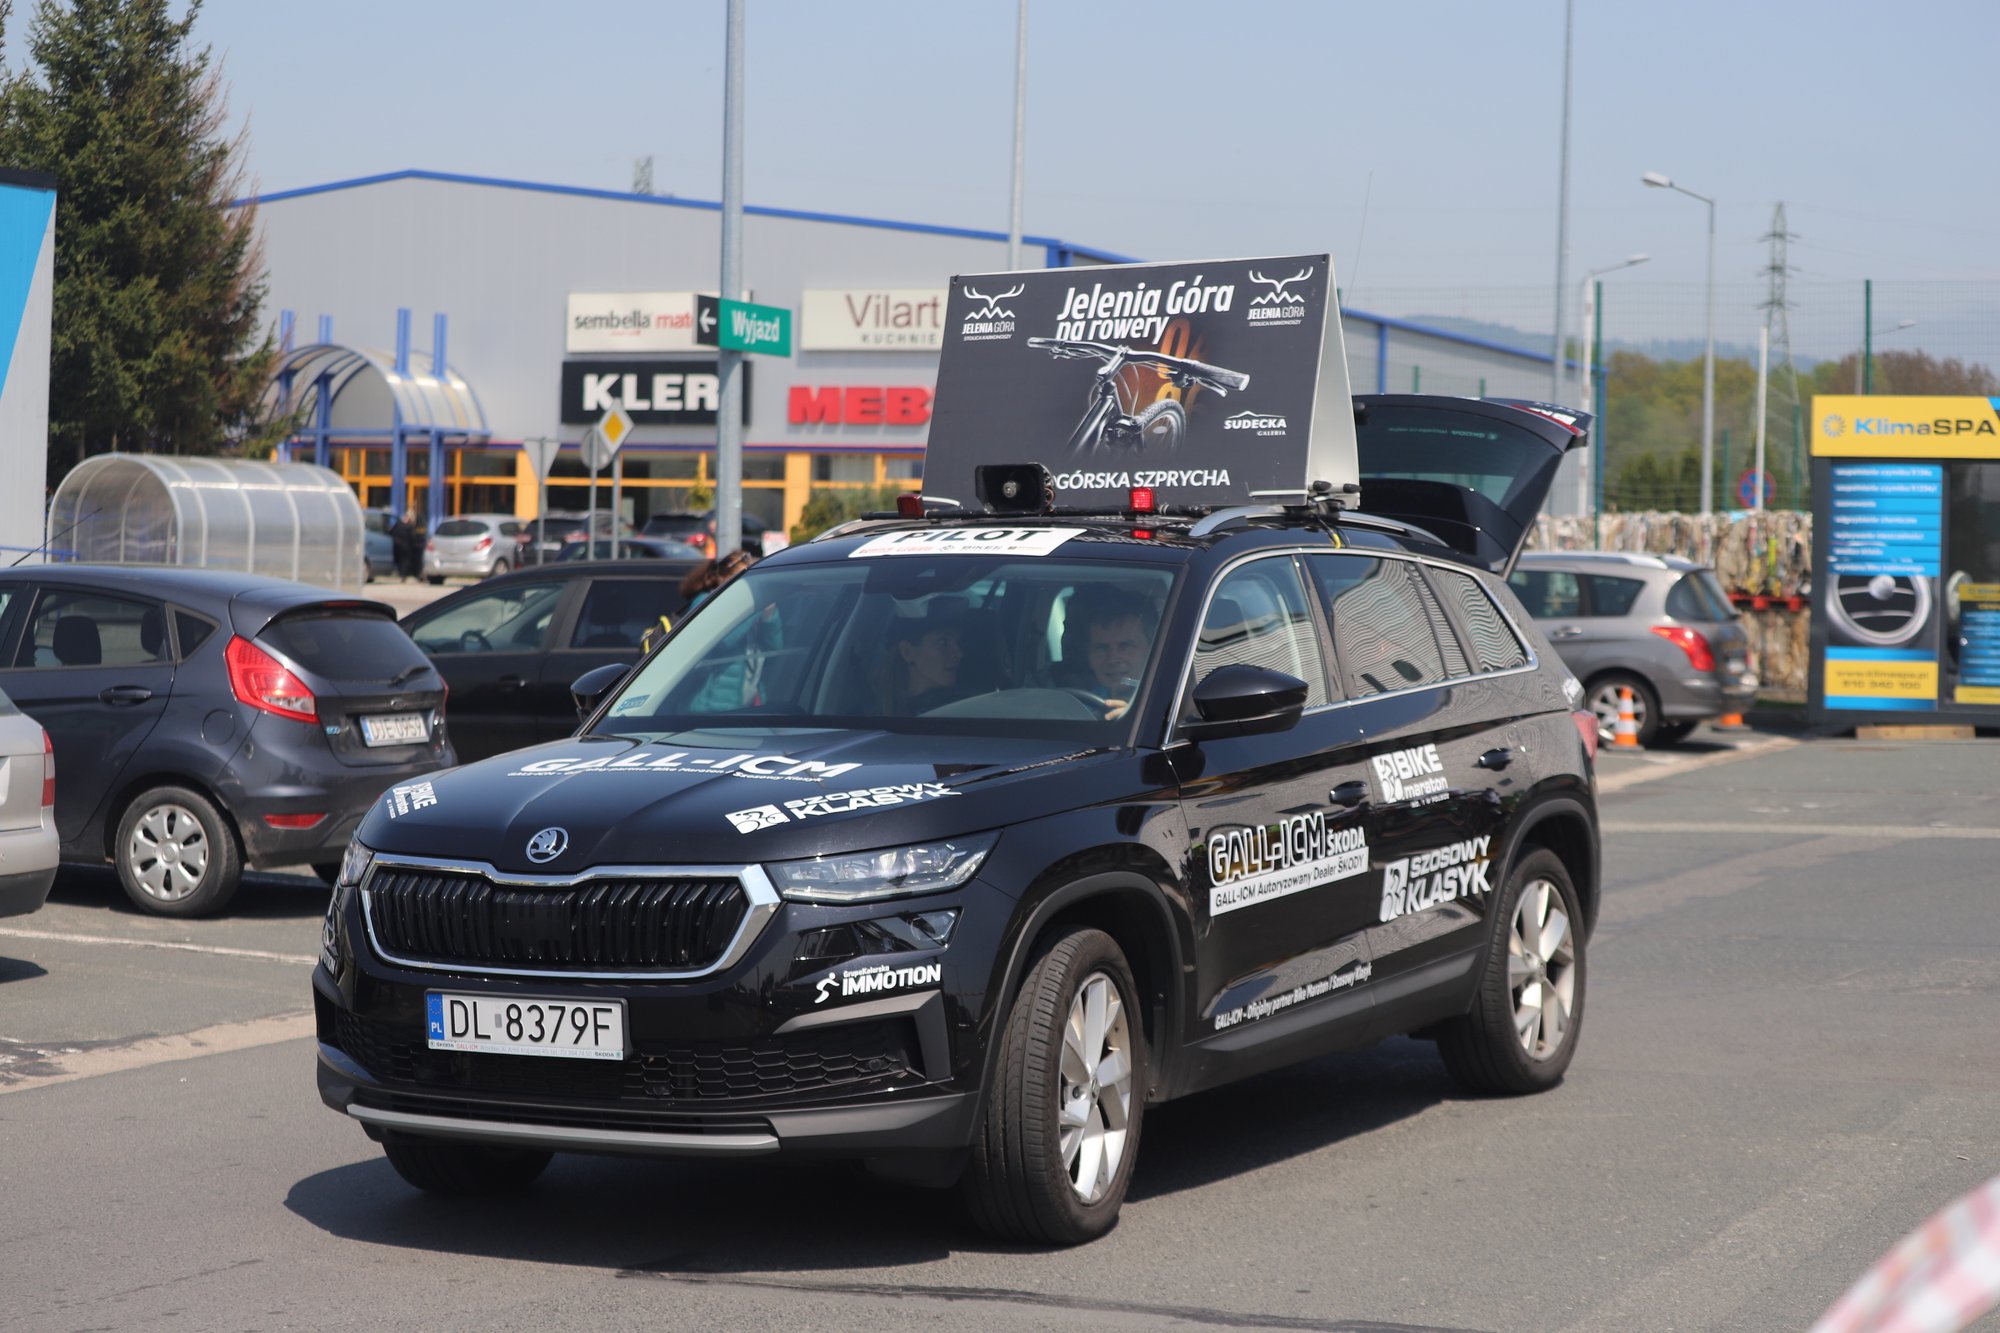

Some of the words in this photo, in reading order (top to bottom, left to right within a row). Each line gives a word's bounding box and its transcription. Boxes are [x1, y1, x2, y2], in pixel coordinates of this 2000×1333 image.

[845, 293, 941, 330] Vilart
[1056, 282, 1162, 321] Jelenia
[1166, 275, 1235, 315] Góra
[1247, 307, 1281, 320] JELENIA
[1281, 305, 1305, 318] GÓRA
[574, 310, 650, 330] sembella
[731, 308, 780, 343] Wyjazd
[962, 322, 993, 334] JELENIA
[993, 320, 1015, 333] GÓRA
[1055, 319, 1087, 341] na
[1087, 316, 1170, 345] rowery
[861, 333, 938, 345] KUCHNIE
[583, 374, 719, 411] KLER
[1224, 418, 1287, 430] SUDECKA
[1854, 418, 1997, 436] KlimaSPA
[1133, 468, 1231, 488] SZPRYCHA
[893, 530, 1051, 544] PILOT
[520, 753, 863, 778] GALL-ICM
[1392, 743, 1443, 779] BIKE
[783, 782, 945, 808] SZOSOWY
[789, 787, 962, 820] KLASYK
[1404, 776, 1449, 800] maraton
[1209, 811, 1326, 887] GALL-ICM
[1327, 826, 1366, 857] ŠKODA
[1410, 835, 1491, 879] SZOSOWY
[1215, 885, 1256, 907] GALL-ICM
[1257, 871, 1313, 896] Autoryzowany
[1313, 864, 1337, 880] Dealer
[1337, 854, 1365, 874] ŠKODY
[1406, 859, 1492, 915] KLASYK
[842, 963, 941, 996] IMMOTION
[450, 999, 492, 1040] DL
[506, 1003, 613, 1046] 8379F
[1214, 1008, 1243, 1031] GALL-ICM
[1271, 993, 1294, 1015] partner
[1293, 986, 1307, 1003] Bike
[431, 1021, 443, 1034] PL
